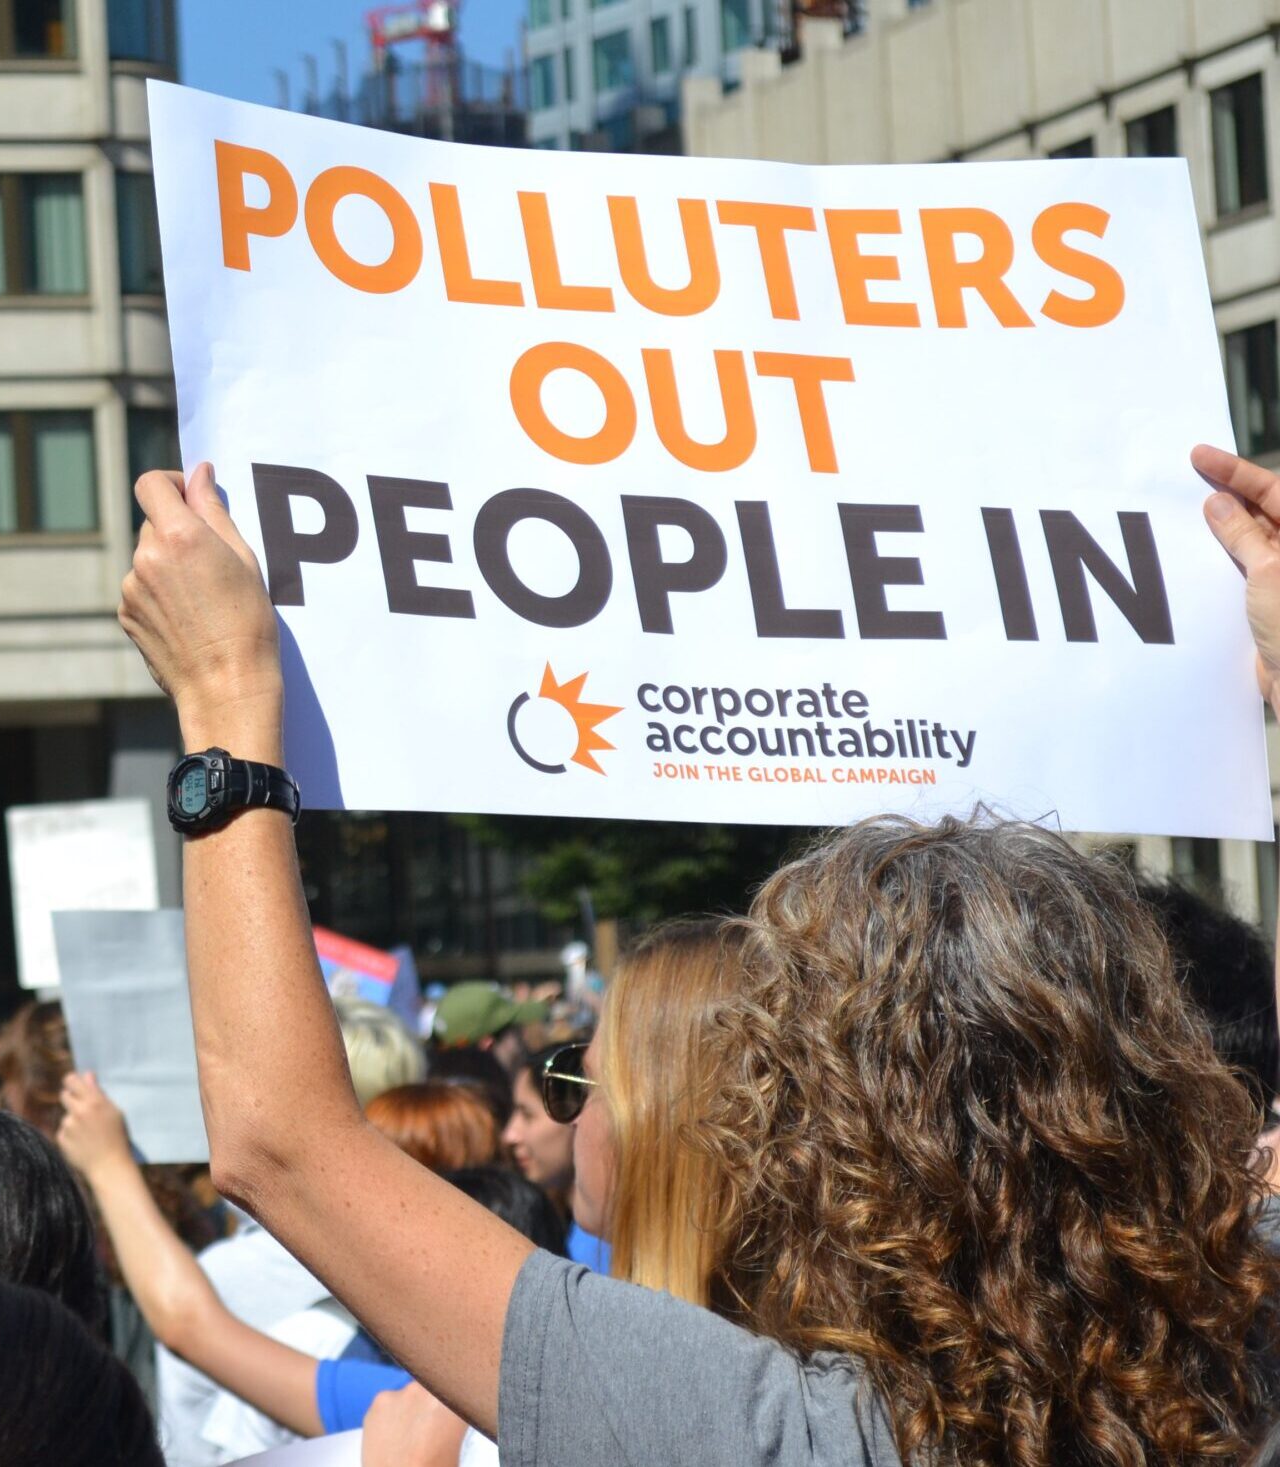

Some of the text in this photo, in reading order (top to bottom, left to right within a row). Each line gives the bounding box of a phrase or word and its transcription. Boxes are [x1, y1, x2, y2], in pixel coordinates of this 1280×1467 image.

[216, 140, 1125, 328] POLLUTERS
[509, 342, 854, 473] OUT
[251, 463, 1175, 645] PEOPLE IN
[637, 682, 870, 726] corporate
[645, 719, 977, 768] accountability
[653, 762, 937, 785] JOIN THE GLOBAL CAMPAIGN
